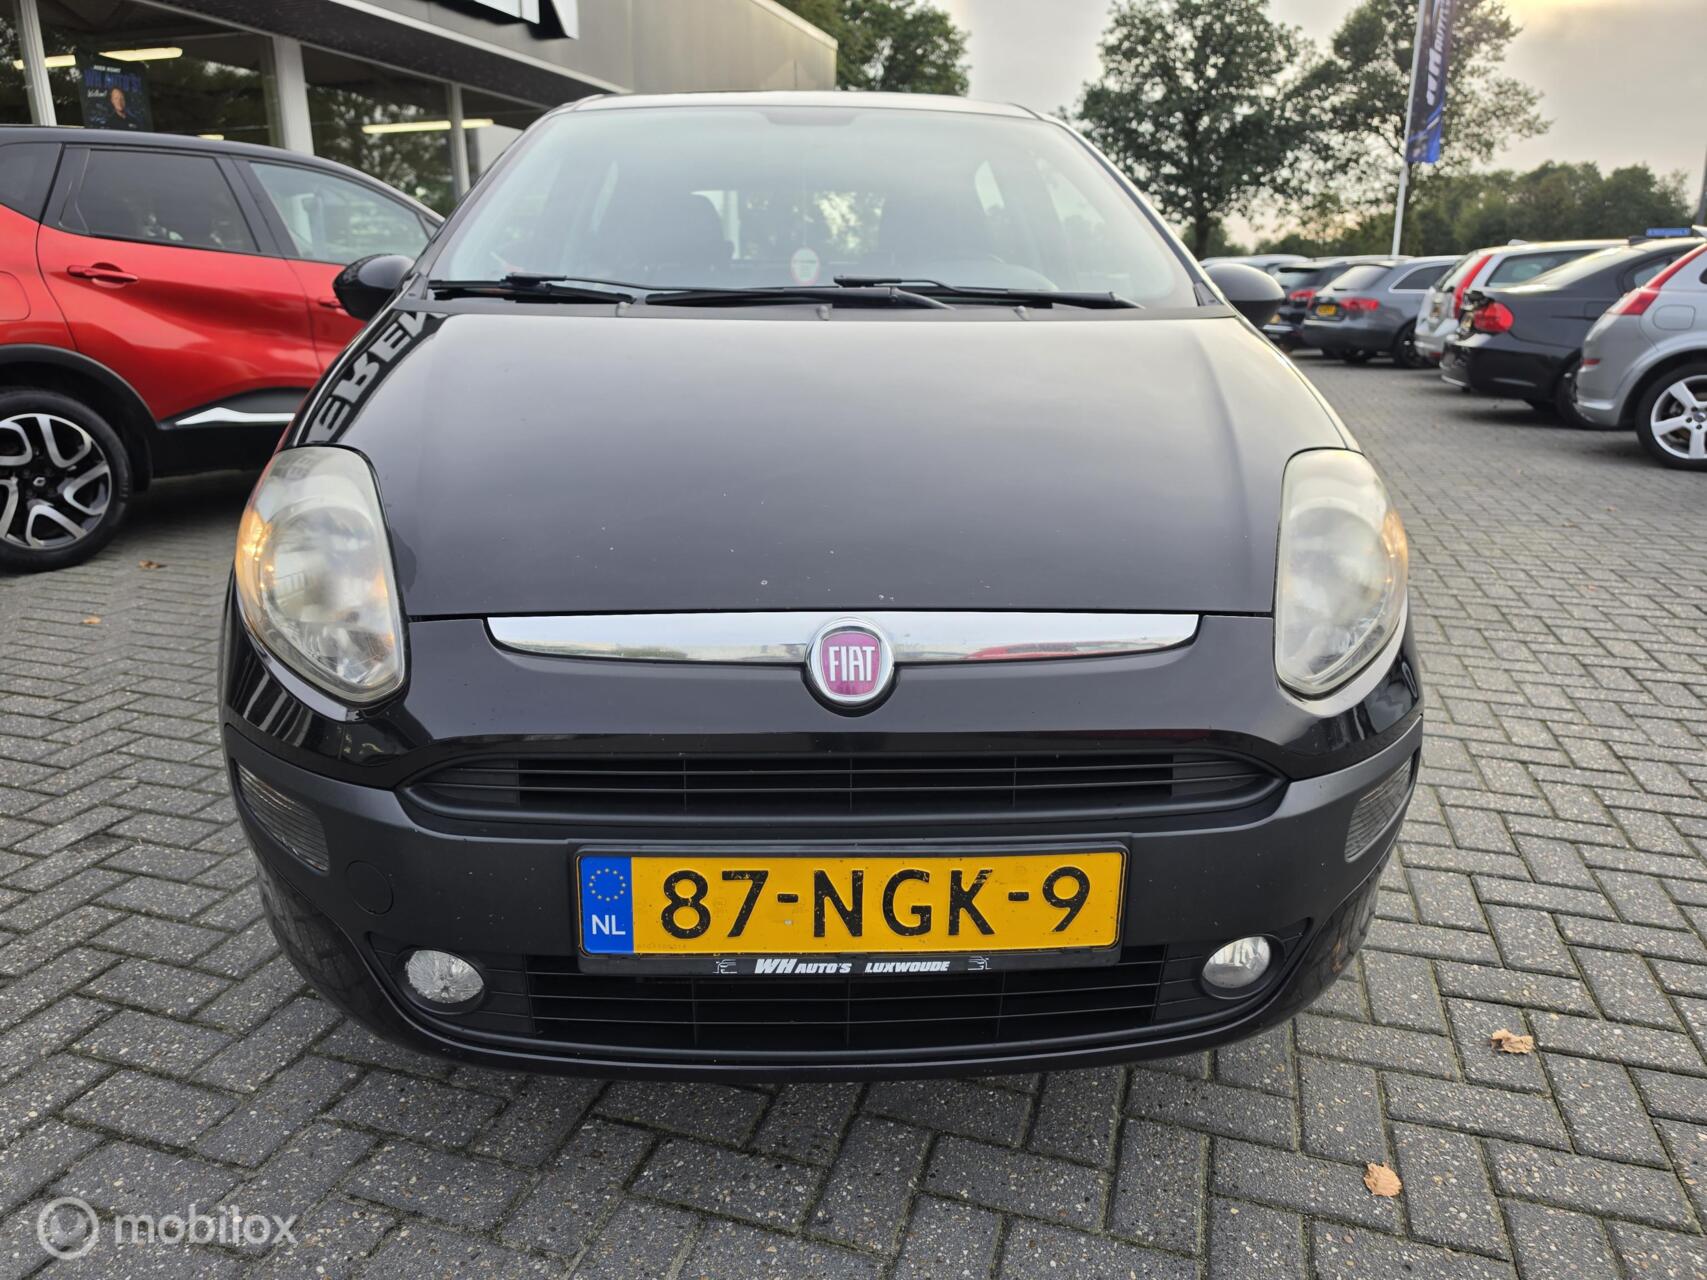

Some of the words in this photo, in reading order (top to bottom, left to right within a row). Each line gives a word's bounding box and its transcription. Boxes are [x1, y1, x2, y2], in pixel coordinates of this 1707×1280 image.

[828, 645, 876, 682] FIAT
[660, 866, 1091, 940] 87-NGK-9
[591, 914, 626, 936] NL
[755, 958, 798, 974] WH
[796, 962, 852, 974] AUTO'S
[864, 961, 951, 973] LUXWOUDE
